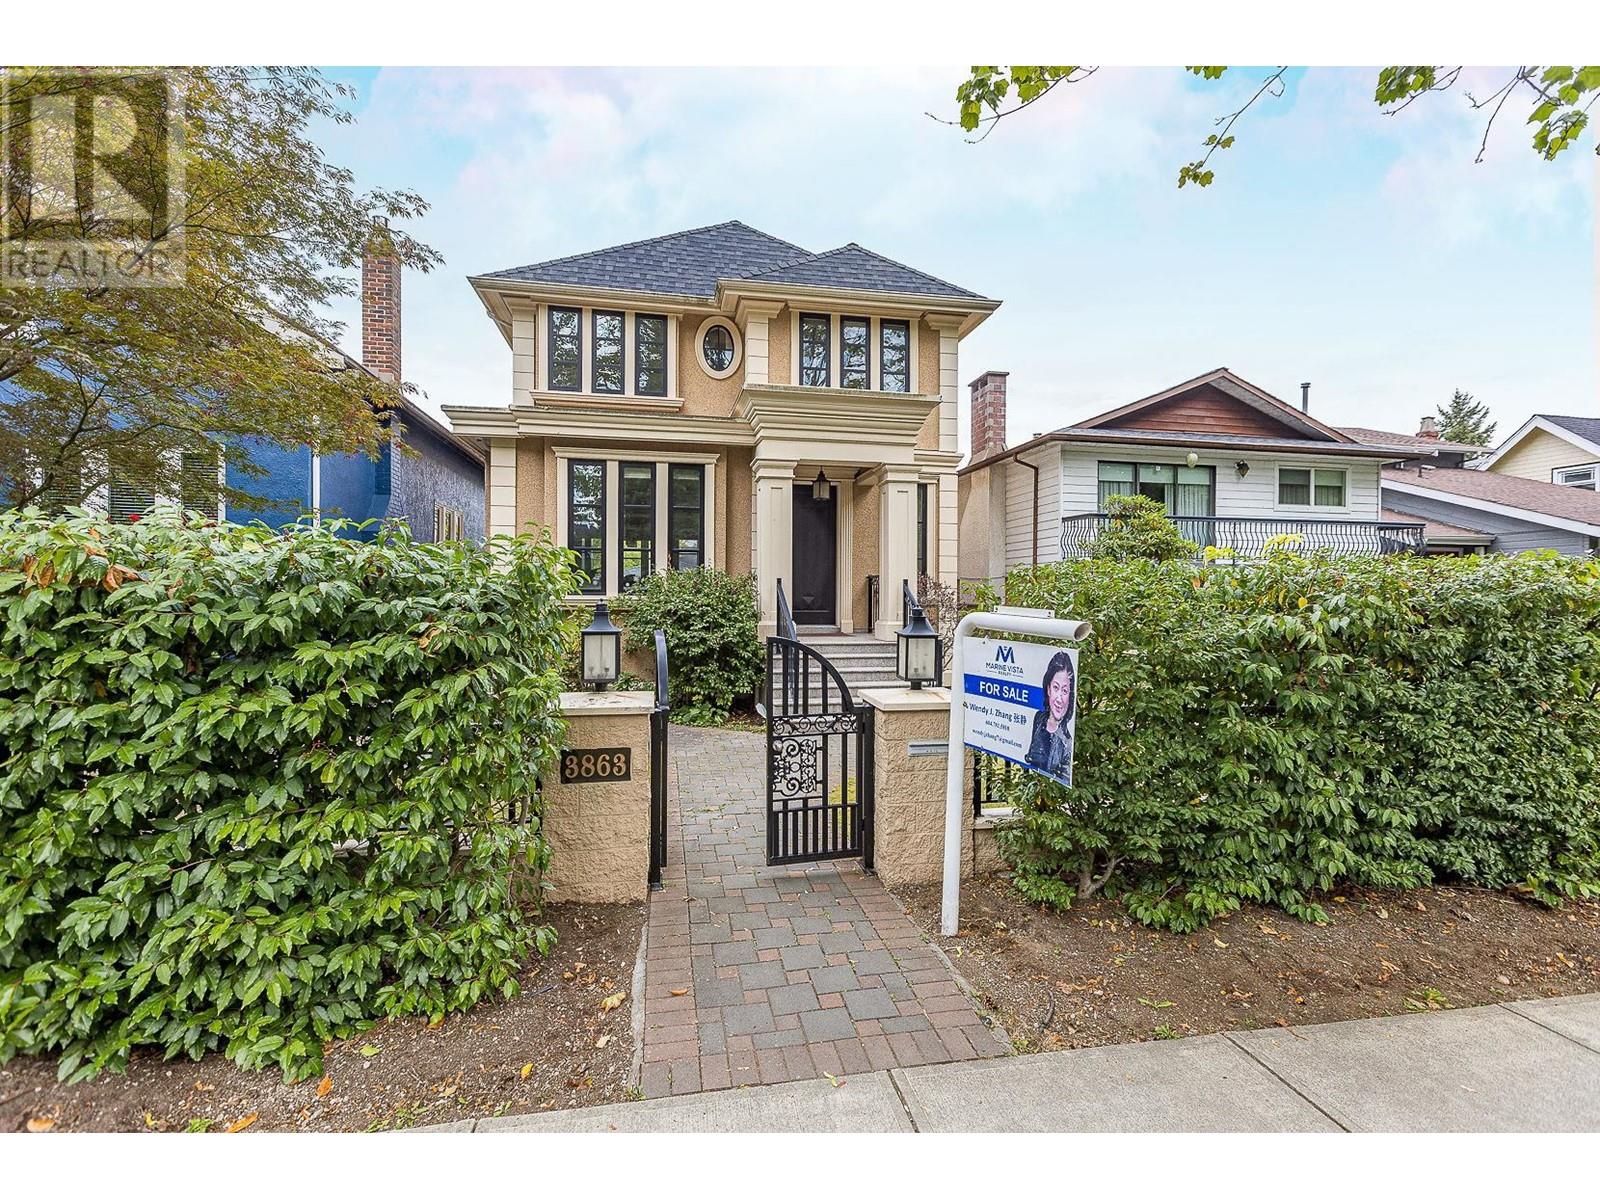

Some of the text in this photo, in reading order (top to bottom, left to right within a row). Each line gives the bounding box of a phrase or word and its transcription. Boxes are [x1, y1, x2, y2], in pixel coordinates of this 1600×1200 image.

[985, 662, 1024, 675] MARINE VISTA
[979, 680, 1030, 703] FOR SALE
[969, 703, 988, 716] Wendy
[995, 708, 1012, 722] Zhang
[565, 753, 627, 779] 3863
